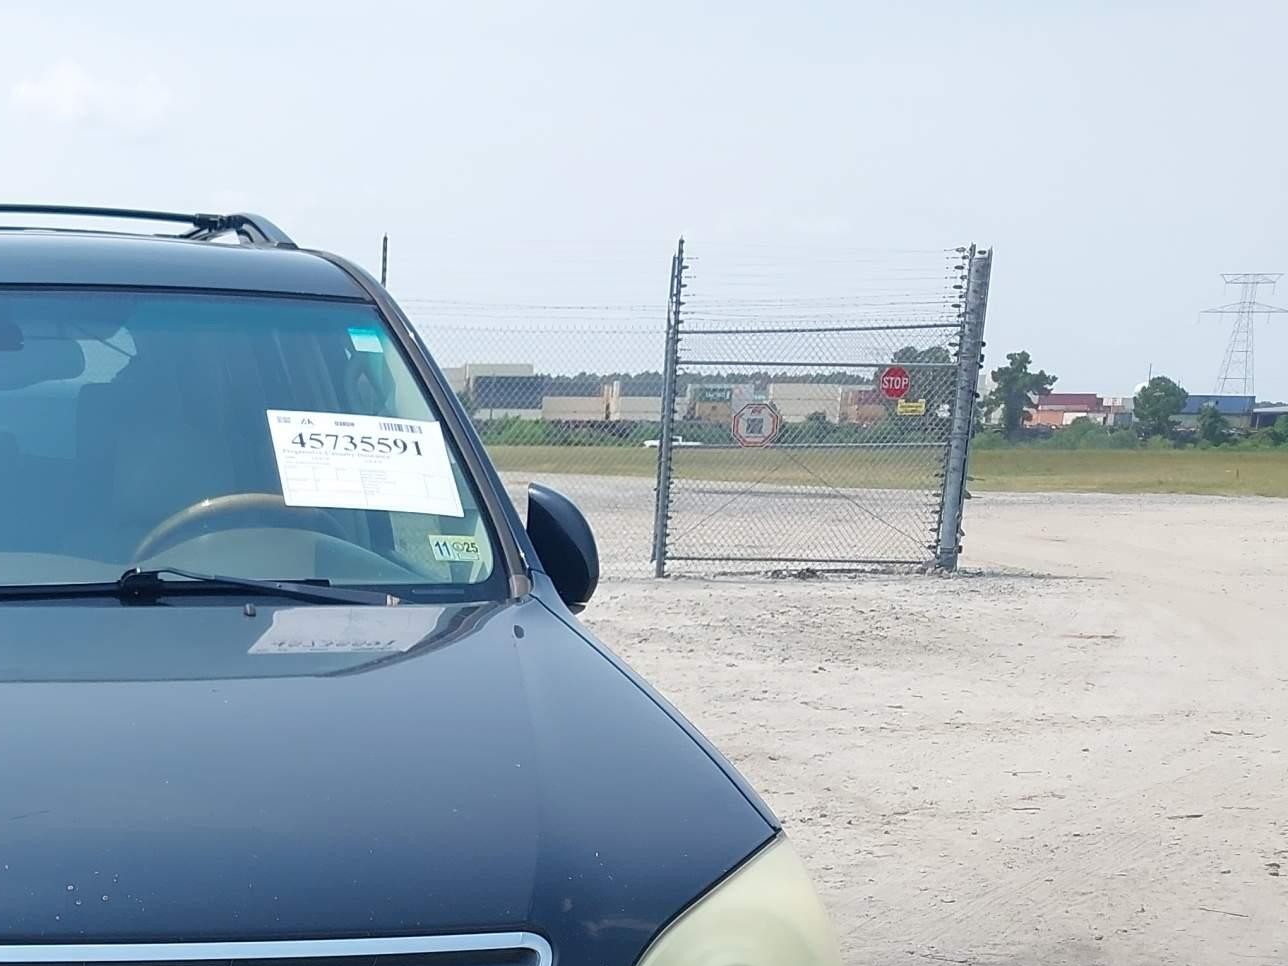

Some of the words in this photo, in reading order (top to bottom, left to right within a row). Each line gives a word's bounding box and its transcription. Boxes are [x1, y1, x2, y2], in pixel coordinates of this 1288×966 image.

[882, 377, 909, 389] STOP
[291, 432, 424, 456] 45735591
[435, 541, 451, 557] 11
[464, 542, 479, 553] 25
